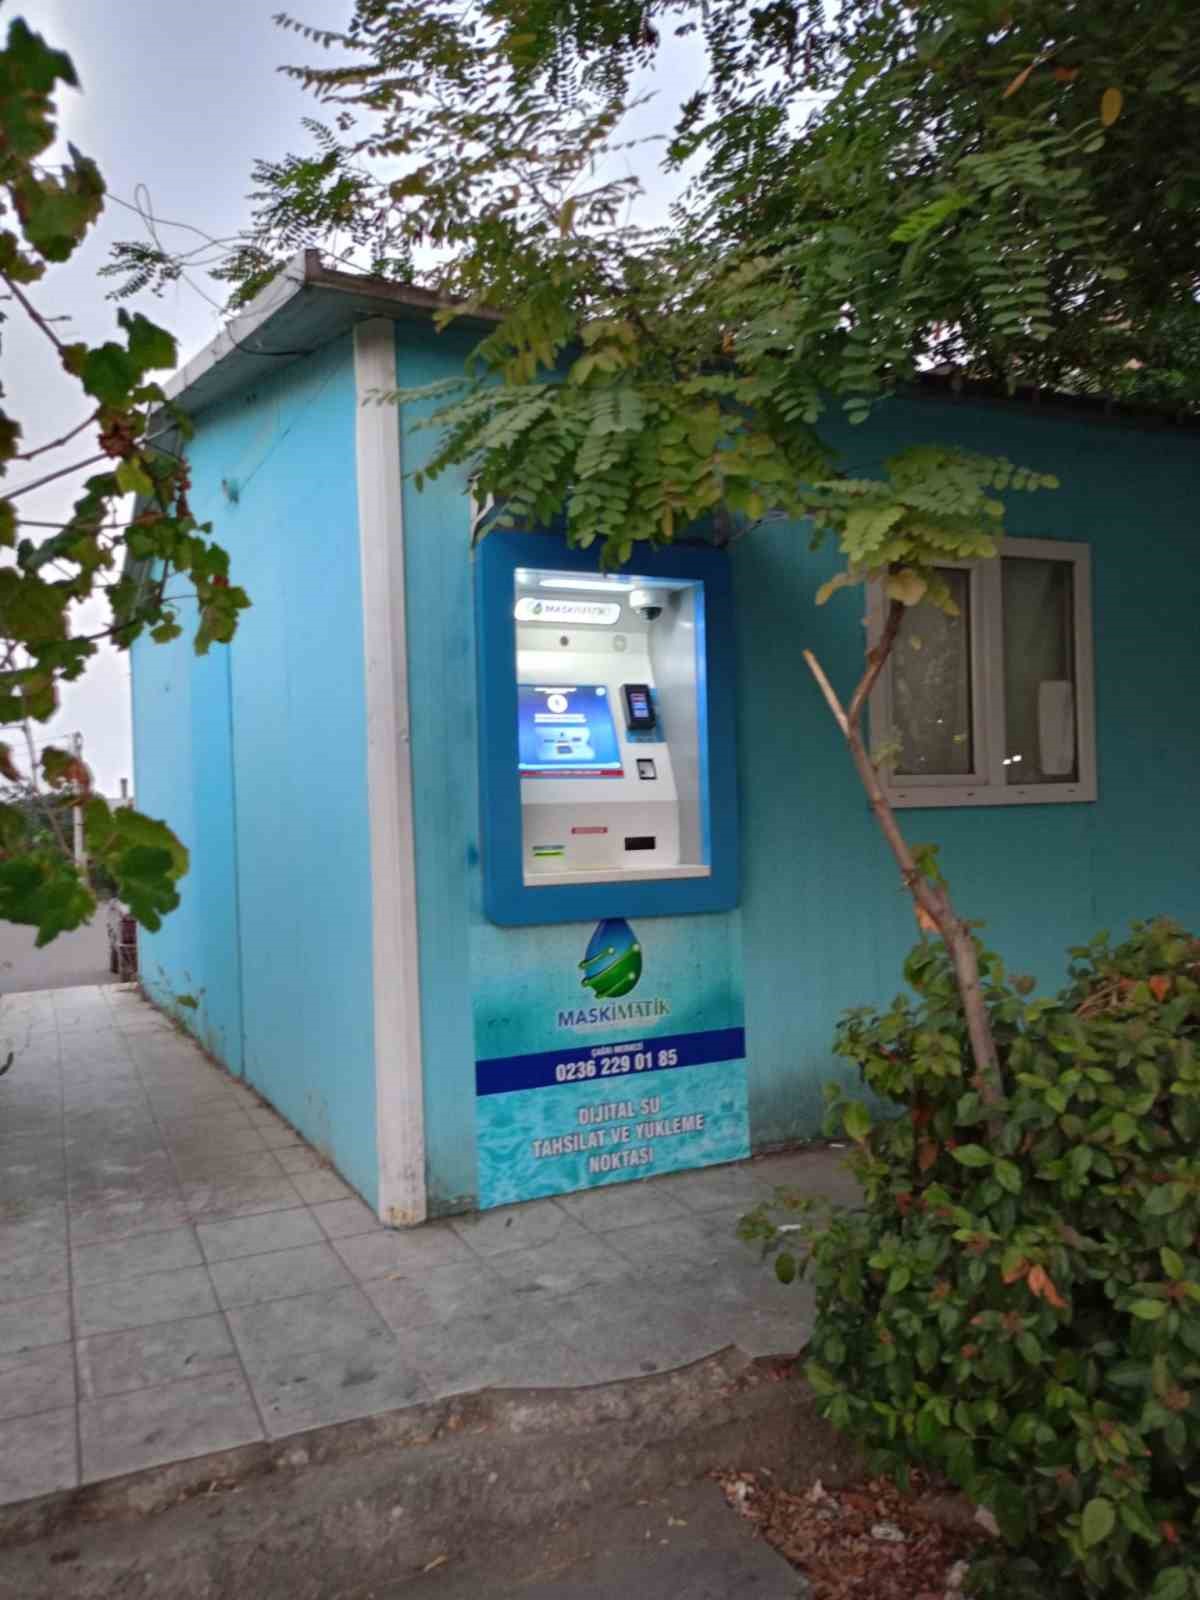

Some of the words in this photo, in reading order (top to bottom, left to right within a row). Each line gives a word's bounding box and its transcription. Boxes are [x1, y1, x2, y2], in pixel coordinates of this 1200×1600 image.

[555, 1060, 596, 1081] 0236
[600, 1055, 630, 1075] 229
[635, 1053, 652, 1070] 01
[658, 1049, 677, 1067] 85
[641, 1097, 660, 1114] SU
[611, 1127, 631, 1143] VE
[589, 1148, 653, 1173] NOKTASI
